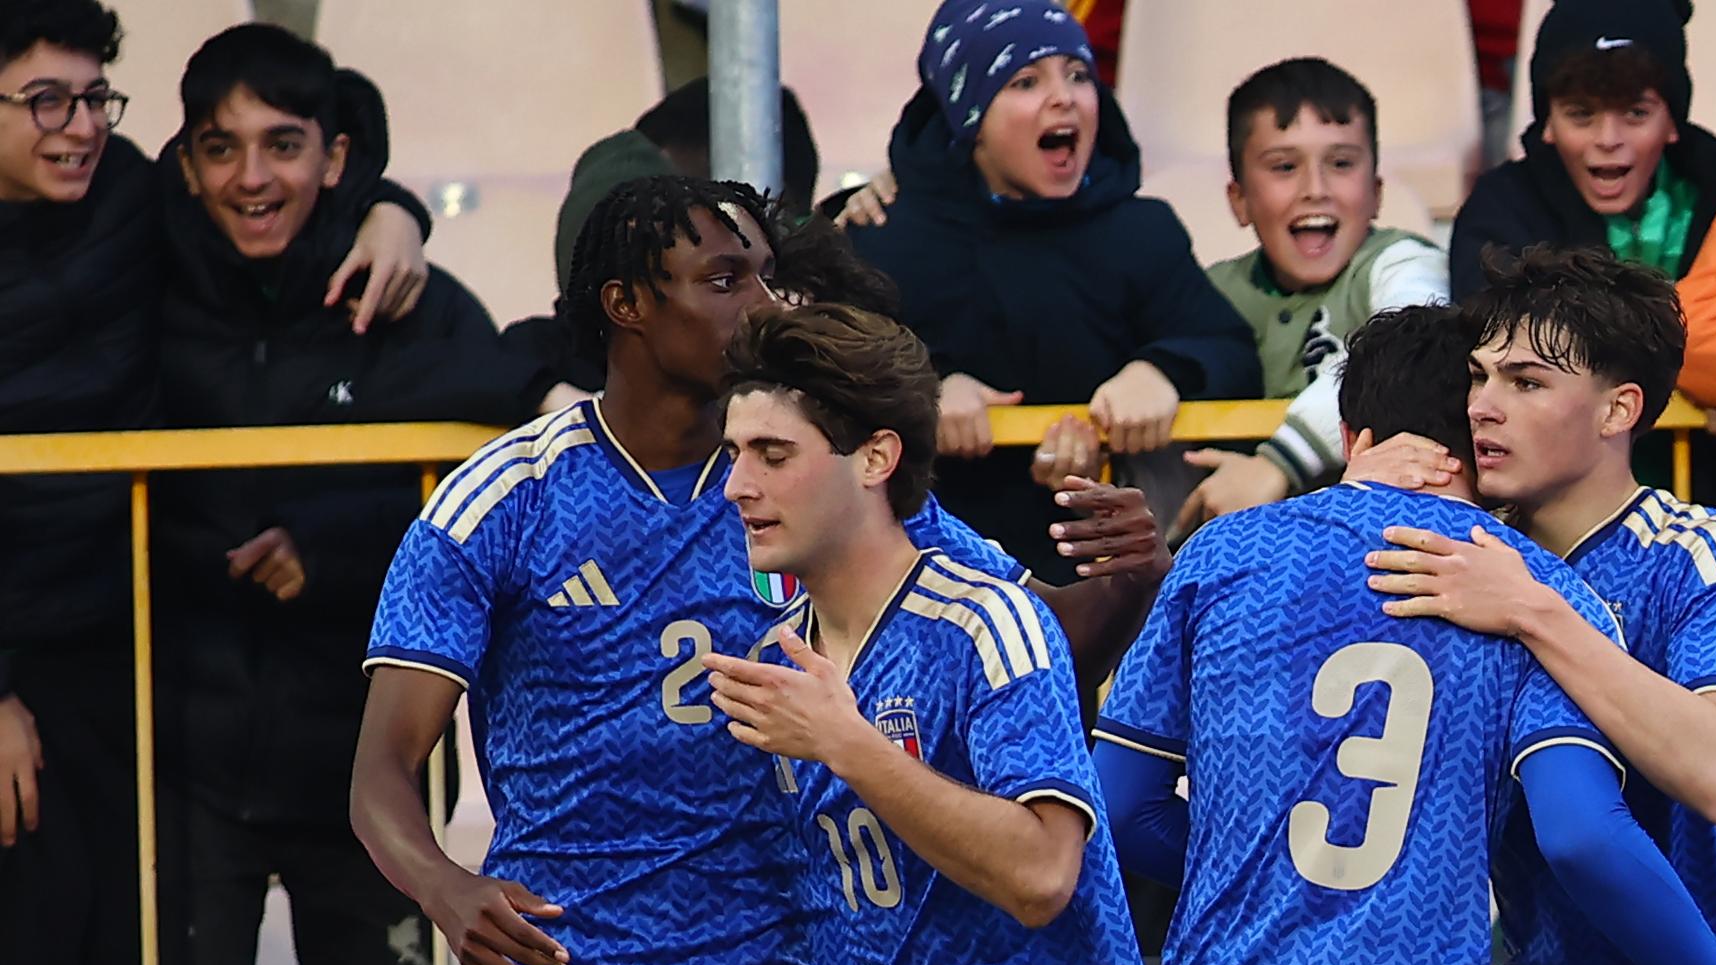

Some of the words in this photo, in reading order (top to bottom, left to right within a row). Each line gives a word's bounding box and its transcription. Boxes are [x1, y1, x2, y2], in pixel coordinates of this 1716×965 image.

[660, 619, 712, 724] 2
[878, 716, 914, 734] ITALIA
[1289, 642, 1434, 890] 3
[817, 807, 900, 912] 10
